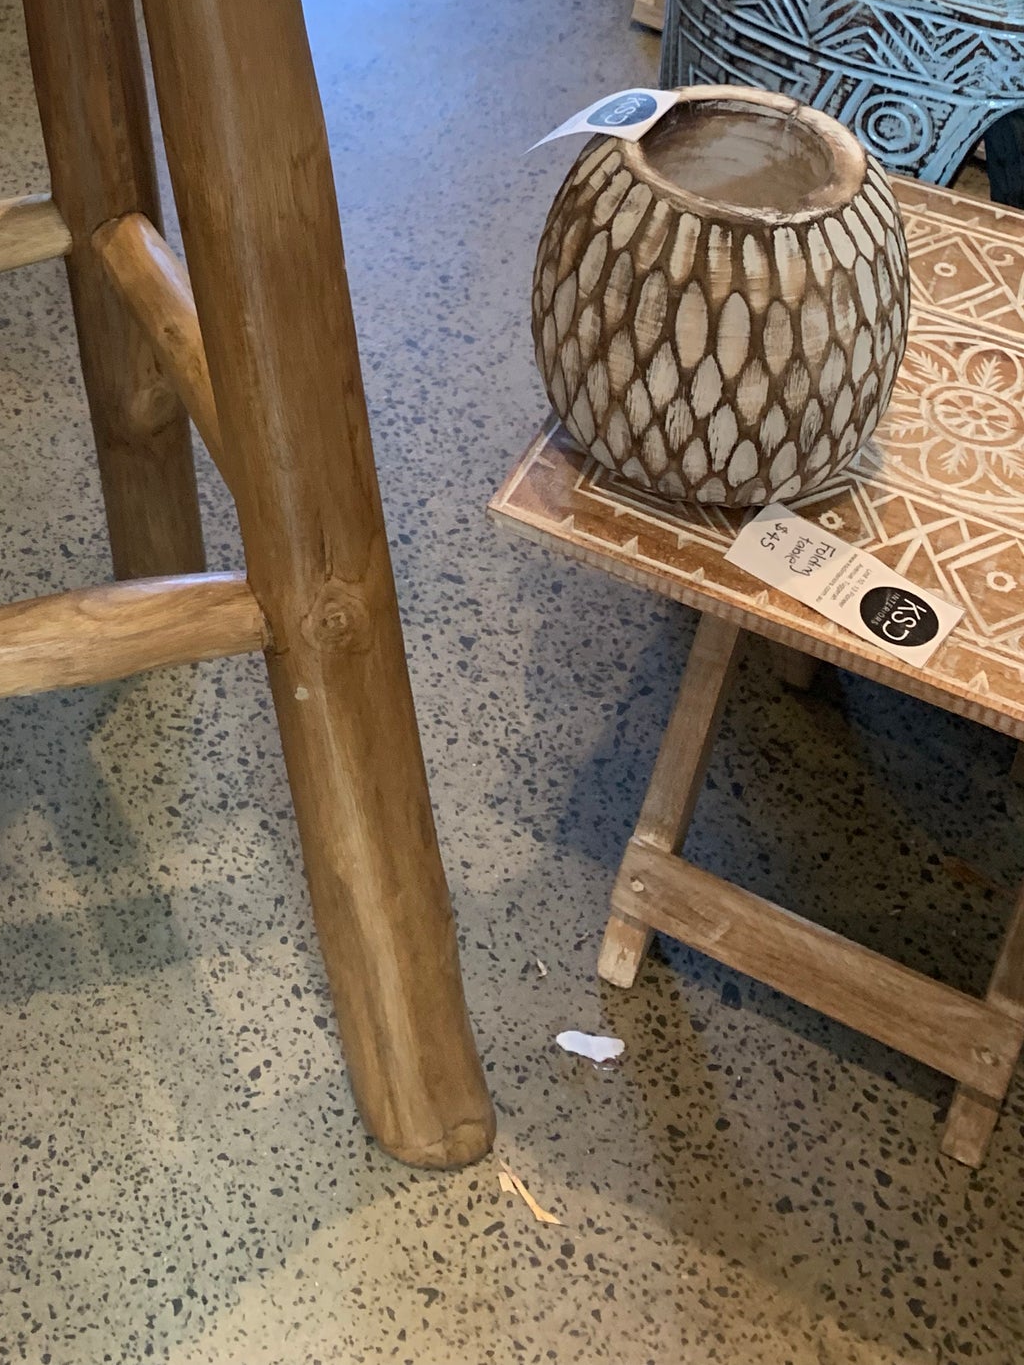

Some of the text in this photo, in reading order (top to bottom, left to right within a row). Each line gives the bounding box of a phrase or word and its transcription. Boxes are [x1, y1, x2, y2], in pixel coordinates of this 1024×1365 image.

[760, 522, 788, 551] $45
[784, 536, 814, 564] table
[789, 541, 836, 577] Folding
[871, 593, 901, 625] INTERIORS
[882, 598, 927, 641] KSD
